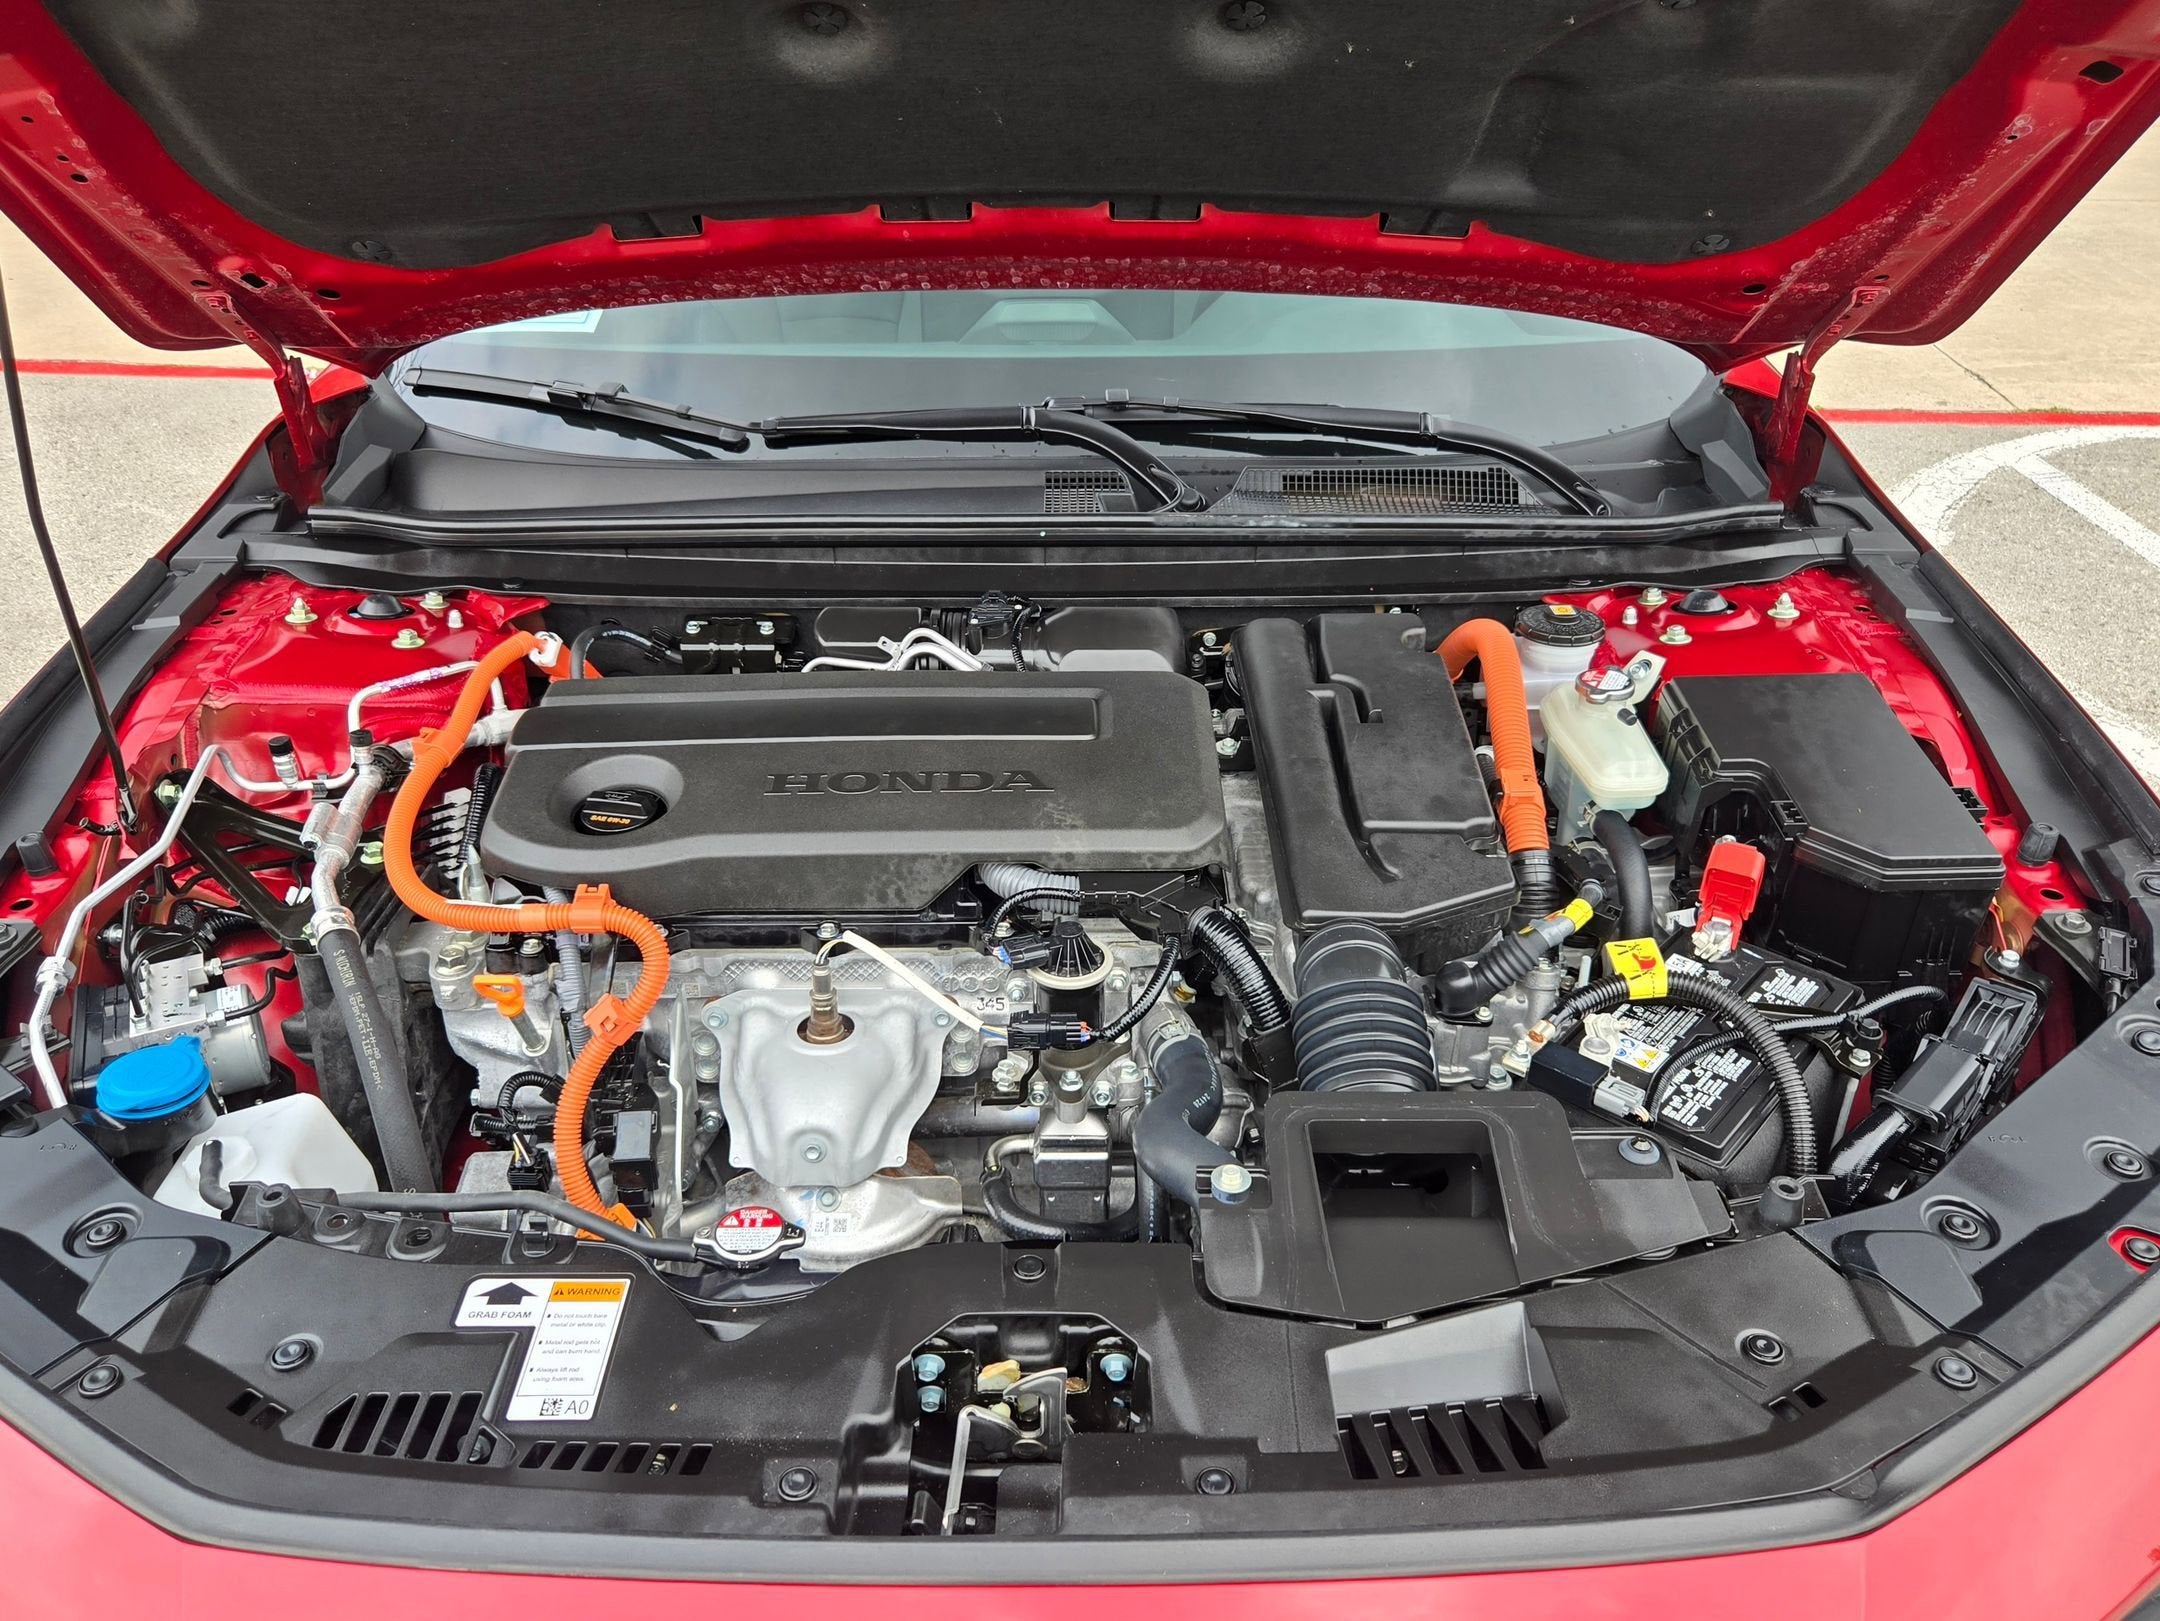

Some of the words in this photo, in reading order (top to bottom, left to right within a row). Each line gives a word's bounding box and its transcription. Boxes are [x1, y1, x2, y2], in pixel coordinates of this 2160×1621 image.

[763, 770, 1055, 796] HONDA
[976, 997, 1005, 1012] 345
[567, 1287, 621, 1296] WARNING
[468, 1311, 498, 1319] GRAB
[500, 1311, 532, 1319] FOAM
[564, 1399, 590, 1415] A0
